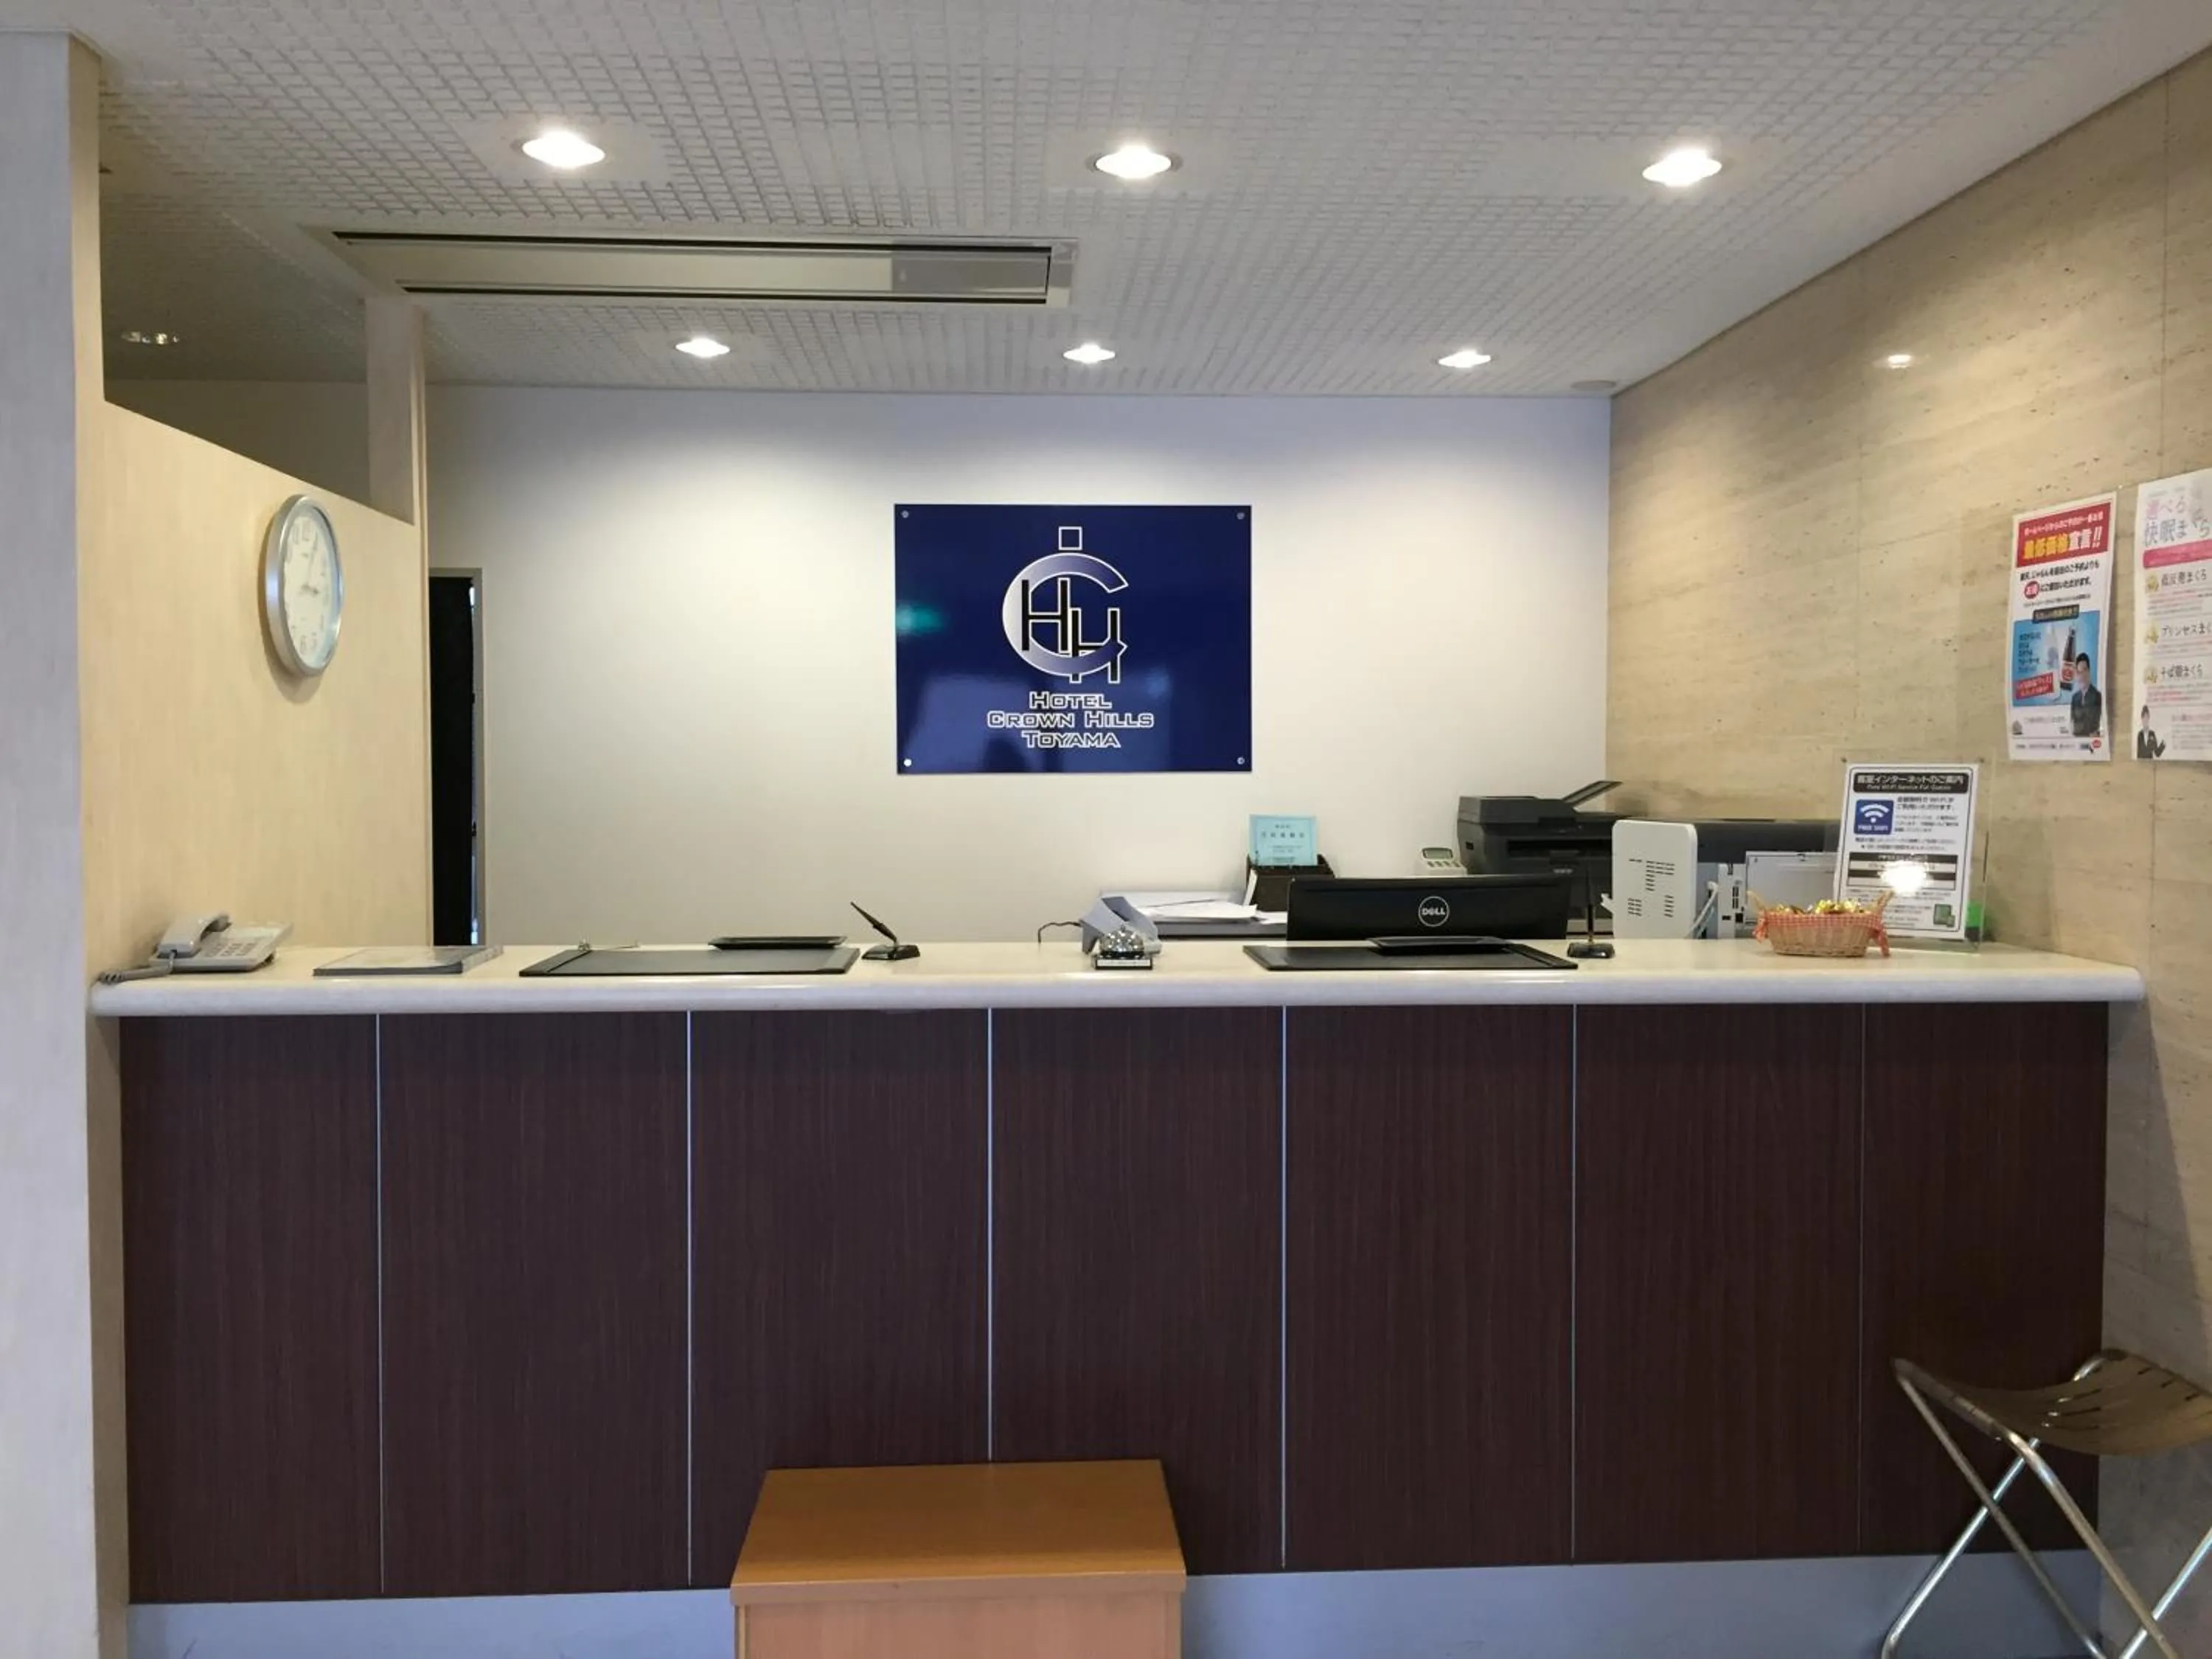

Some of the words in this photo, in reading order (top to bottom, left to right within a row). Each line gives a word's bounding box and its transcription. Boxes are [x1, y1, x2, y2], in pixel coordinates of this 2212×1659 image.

[1029, 691, 1113, 709] HOTEL
[987, 710, 1075, 728] CROWN
[1084, 711, 1154, 728] HILLS
[1021, 730, 1121, 748] TOYAMA
